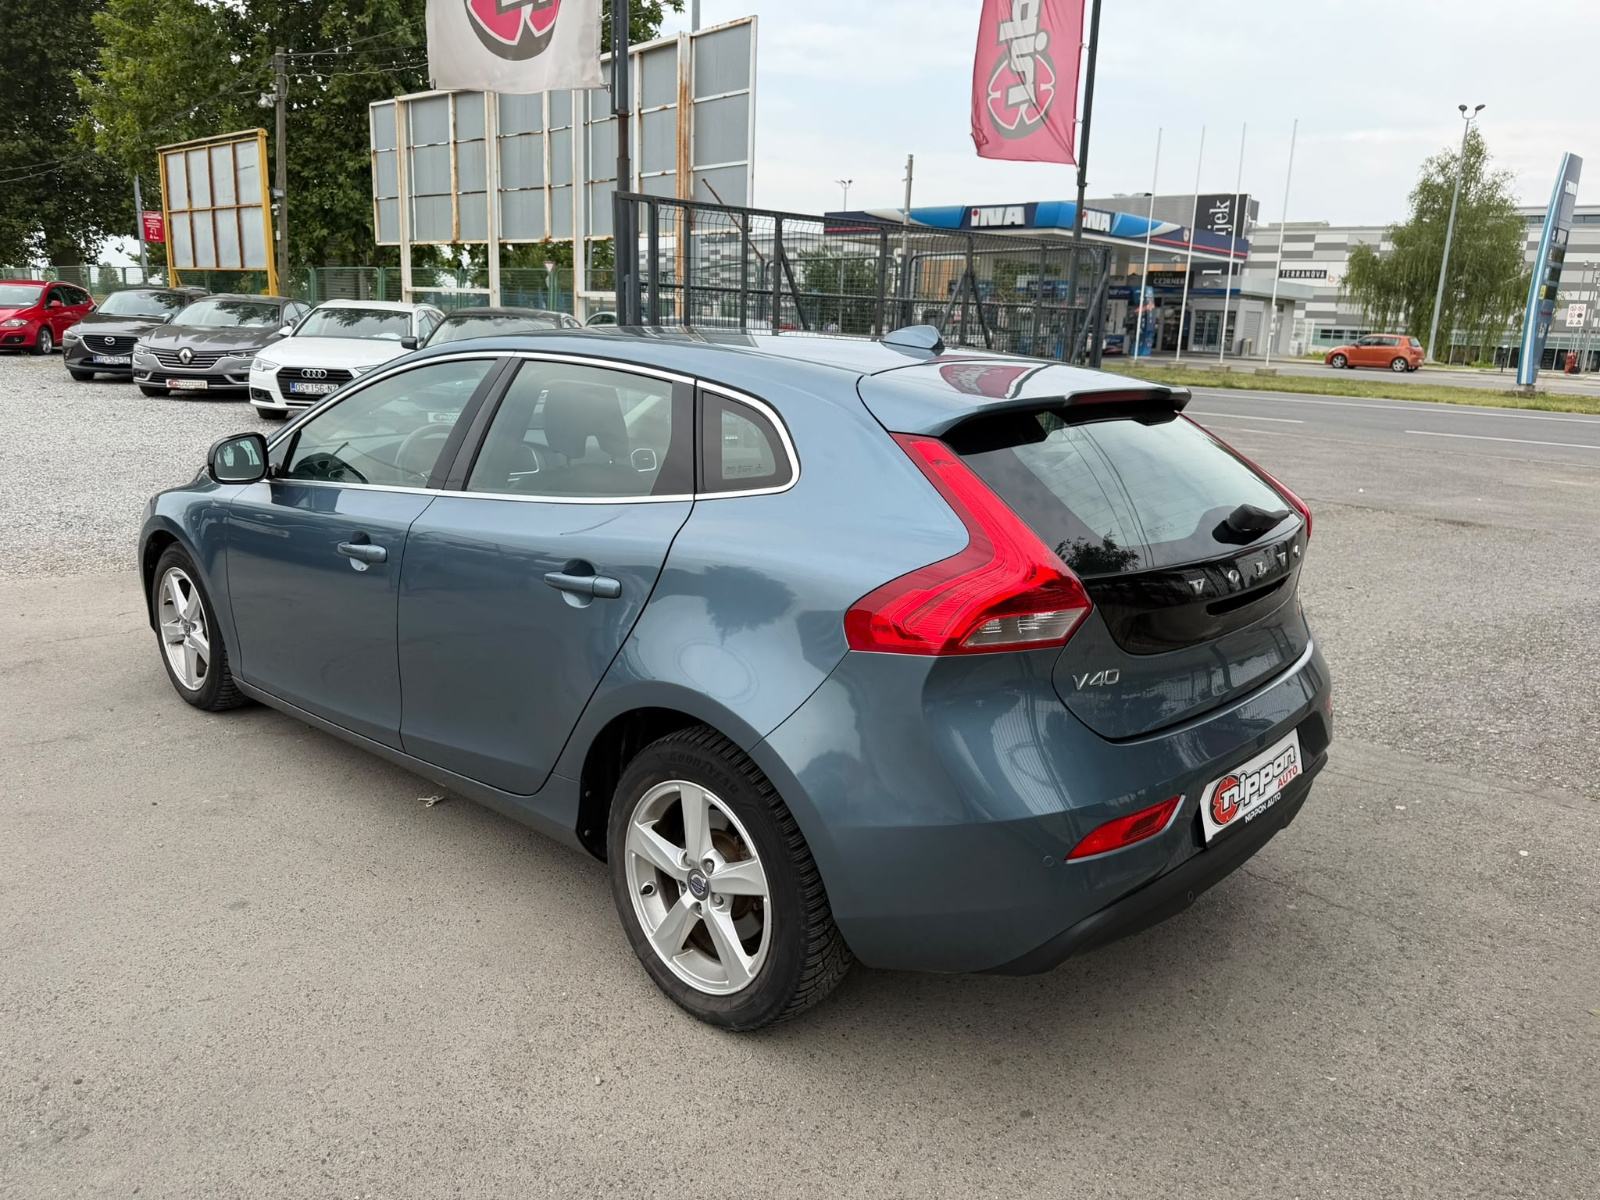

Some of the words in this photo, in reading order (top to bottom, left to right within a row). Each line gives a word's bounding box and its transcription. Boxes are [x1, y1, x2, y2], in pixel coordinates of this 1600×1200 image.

[1281, 270, 1325, 278] TERRANOVA
[1188, 544, 1301, 595] VOLVO
[1072, 669, 1120, 690] V40
[1219, 745, 1296, 812] nippon
[1277, 765, 1298, 789] AUTO
[1244, 804, 1267, 823] NIPPON
[1267, 792, 1282, 808] AUTO
